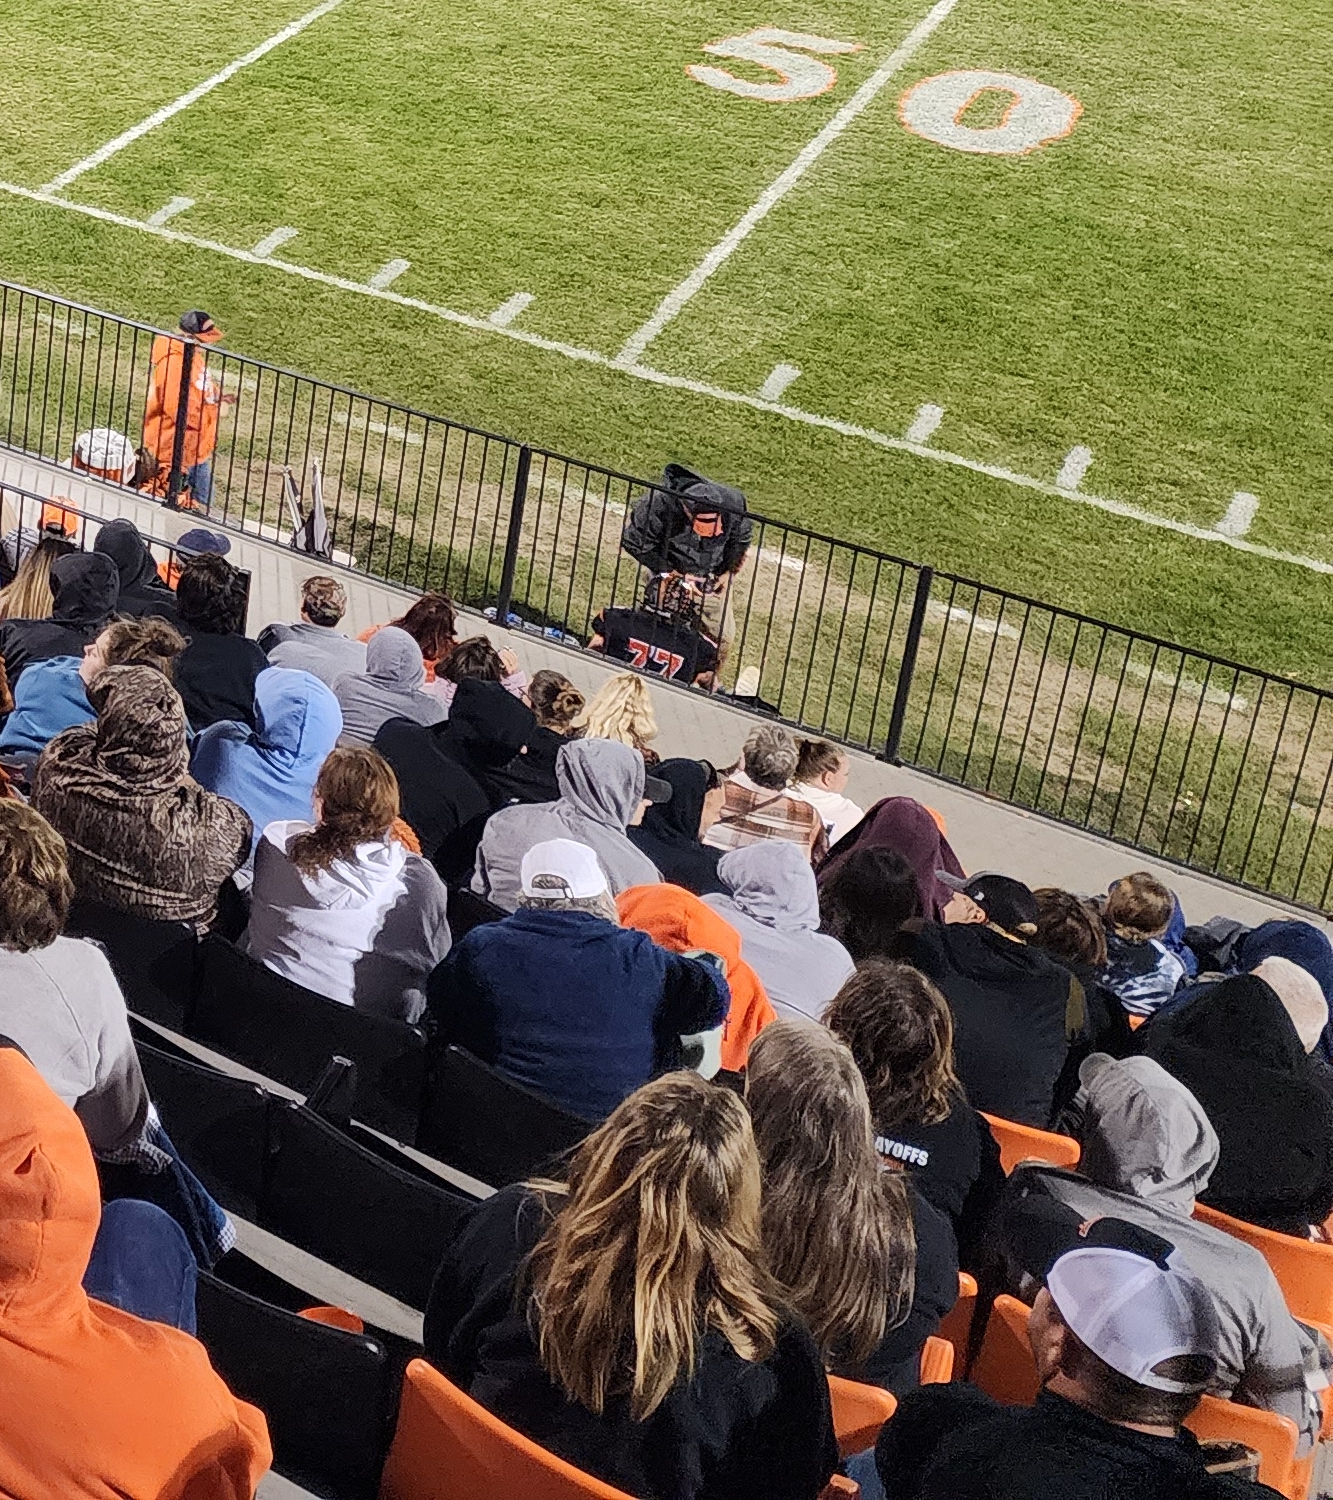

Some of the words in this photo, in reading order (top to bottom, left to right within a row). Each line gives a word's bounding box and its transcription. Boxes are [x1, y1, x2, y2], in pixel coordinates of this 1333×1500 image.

[685, 27, 1084, 156] 50
[627, 637, 685, 682] 77
[874, 1135, 930, 1167] AYOFFS
